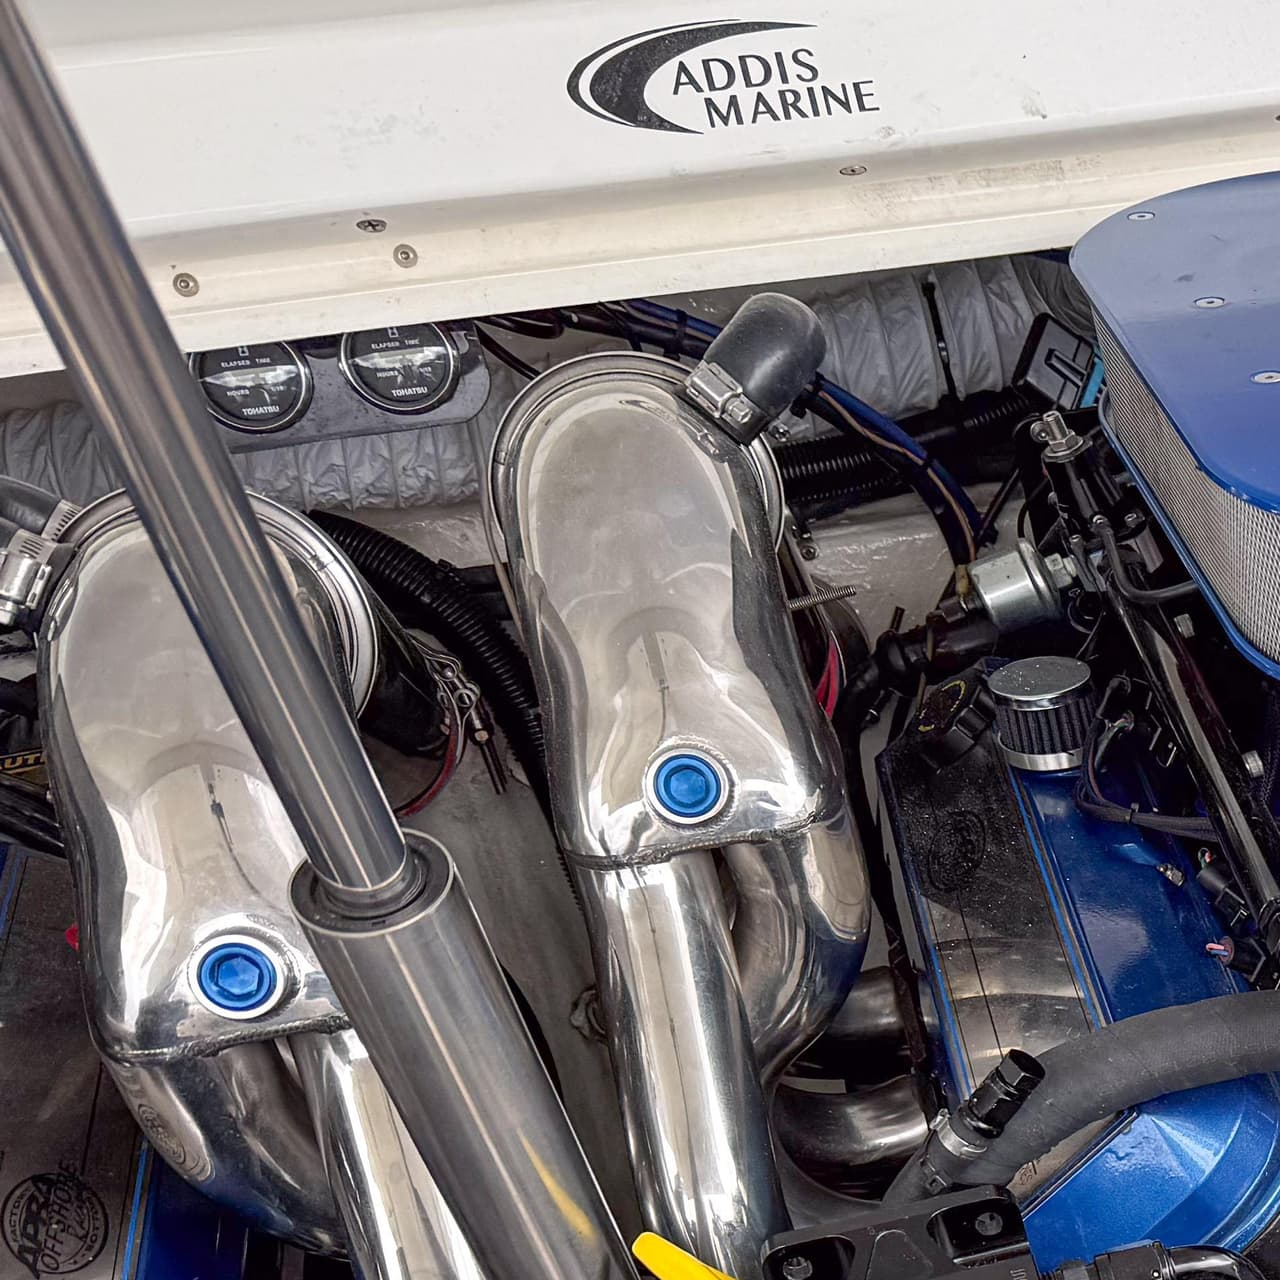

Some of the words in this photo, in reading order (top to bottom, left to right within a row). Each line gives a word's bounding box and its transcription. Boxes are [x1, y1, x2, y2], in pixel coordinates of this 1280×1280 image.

[672, 48, 819, 96] ADDIS
[703, 79, 880, 129] MARINE
[242, 404, 280, 417] TOHATSU
[391, 386, 428, 398] TOHATSU
[41, 1160, 80, 1271] OFFSHORE
